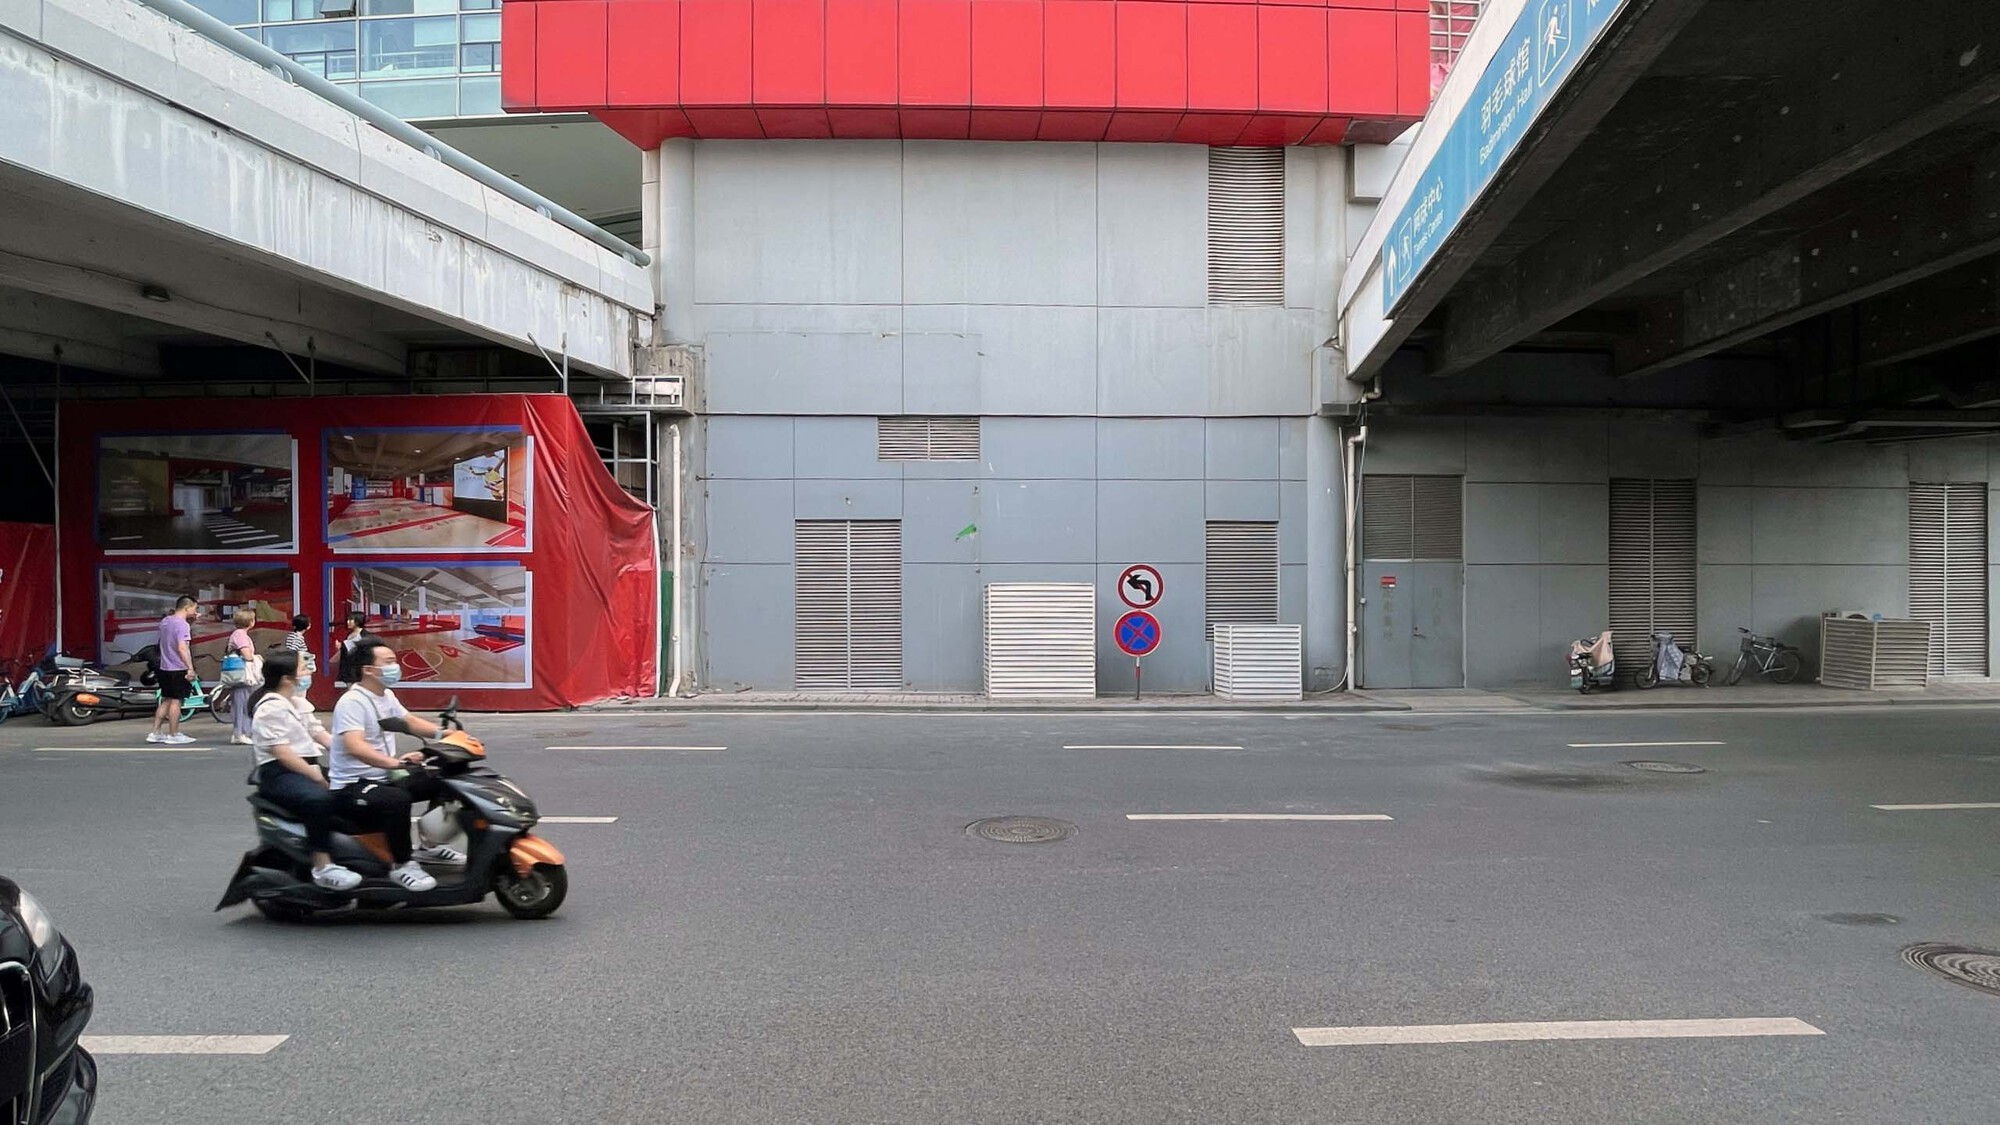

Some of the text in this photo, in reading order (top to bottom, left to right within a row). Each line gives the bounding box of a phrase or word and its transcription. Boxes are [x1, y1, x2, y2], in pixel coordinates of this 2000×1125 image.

[1480, 37, 1530, 134] 羽毛球馆
[1480, 76, 1533, 165] Badminton Hall
[1414, 176, 1443, 236] 网球中心
